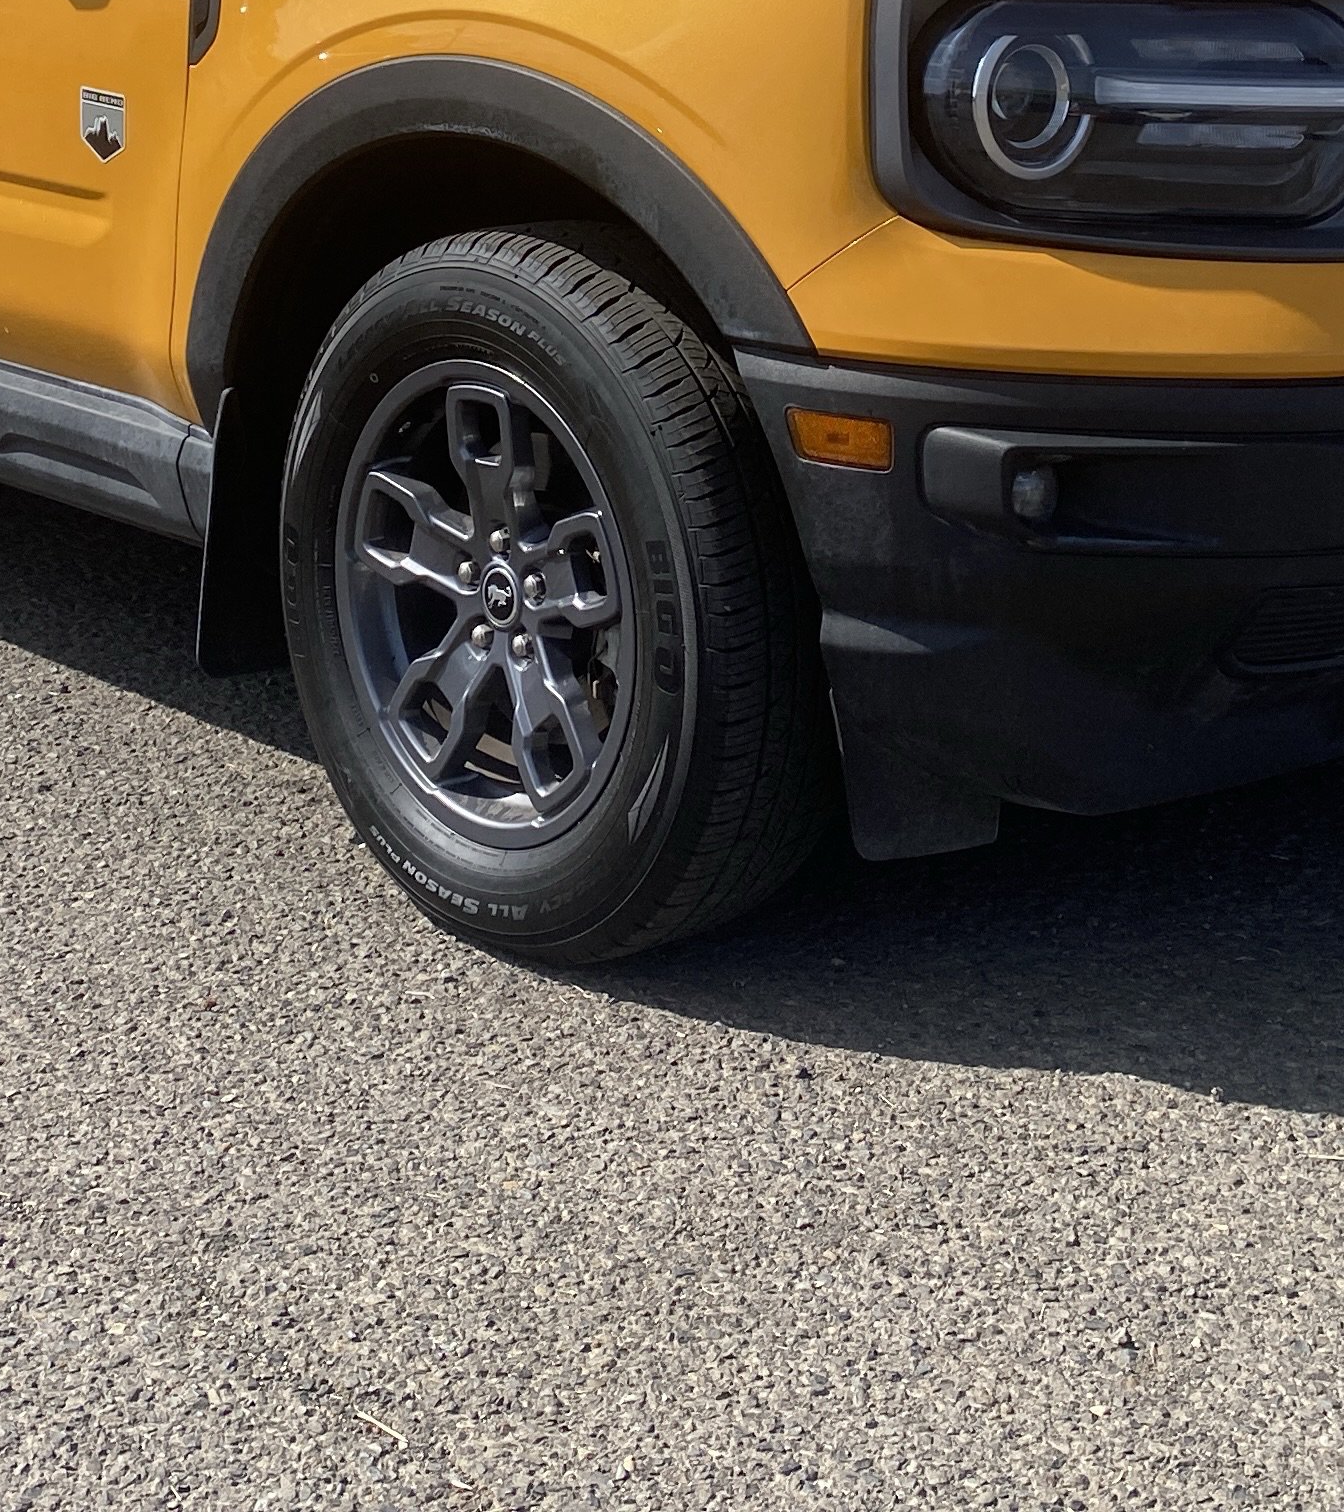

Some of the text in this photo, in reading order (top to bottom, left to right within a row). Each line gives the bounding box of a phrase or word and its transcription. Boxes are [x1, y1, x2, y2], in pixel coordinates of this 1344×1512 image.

[446, 296, 527, 337] SEASON
[527, 330, 567, 367] PLUS
[369, 825, 401, 864] PLUS
[401, 859, 481, 915] SEASON
[487, 902, 529, 921] ALL
